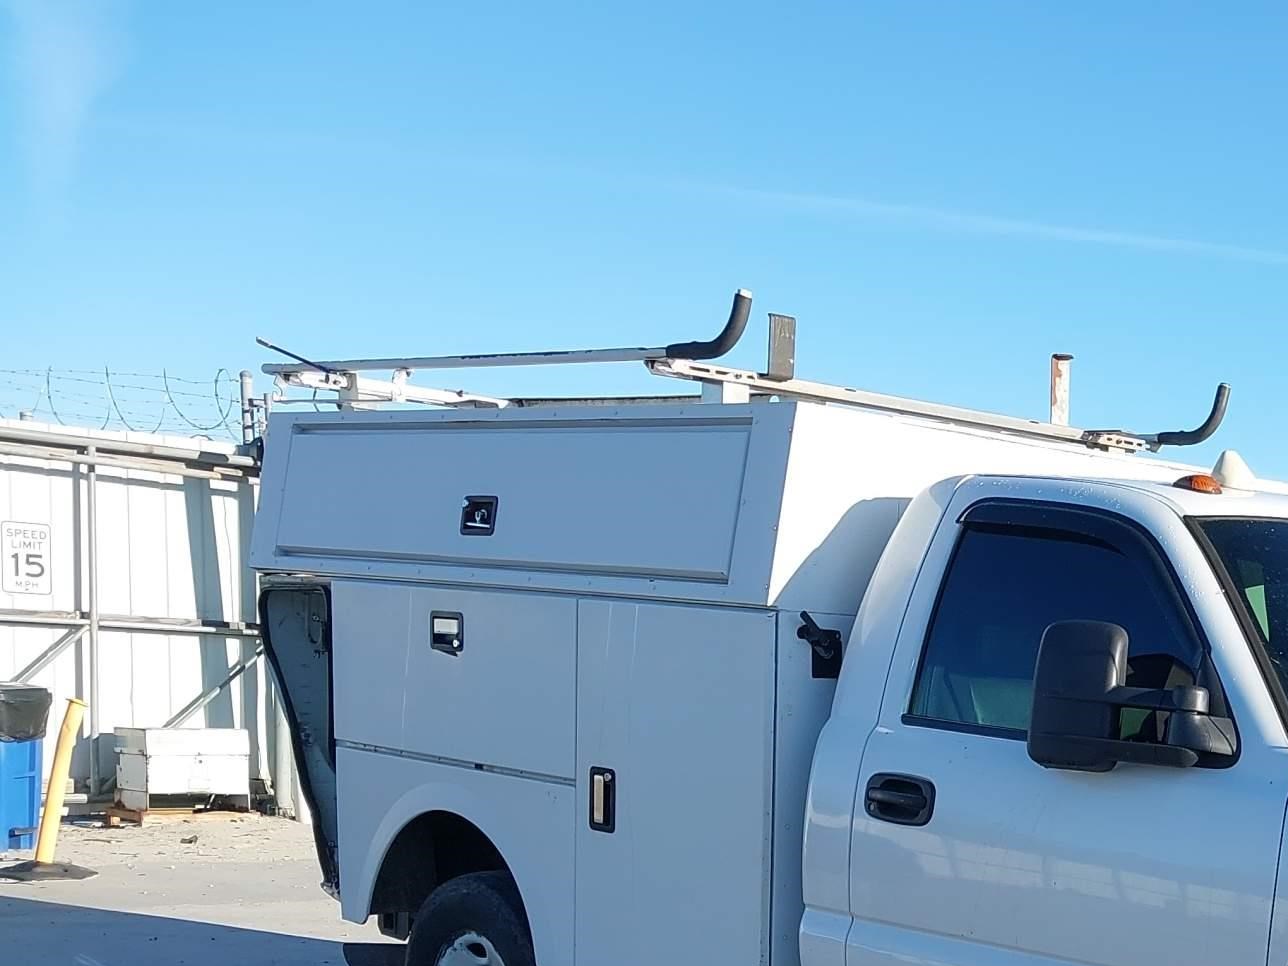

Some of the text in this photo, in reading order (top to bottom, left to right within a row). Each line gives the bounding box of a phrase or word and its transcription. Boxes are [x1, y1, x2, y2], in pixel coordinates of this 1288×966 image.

[6, 528, 47, 540] SPEED
[11, 538, 45, 550] LIMIT
[11, 552, 45, 578] 15
